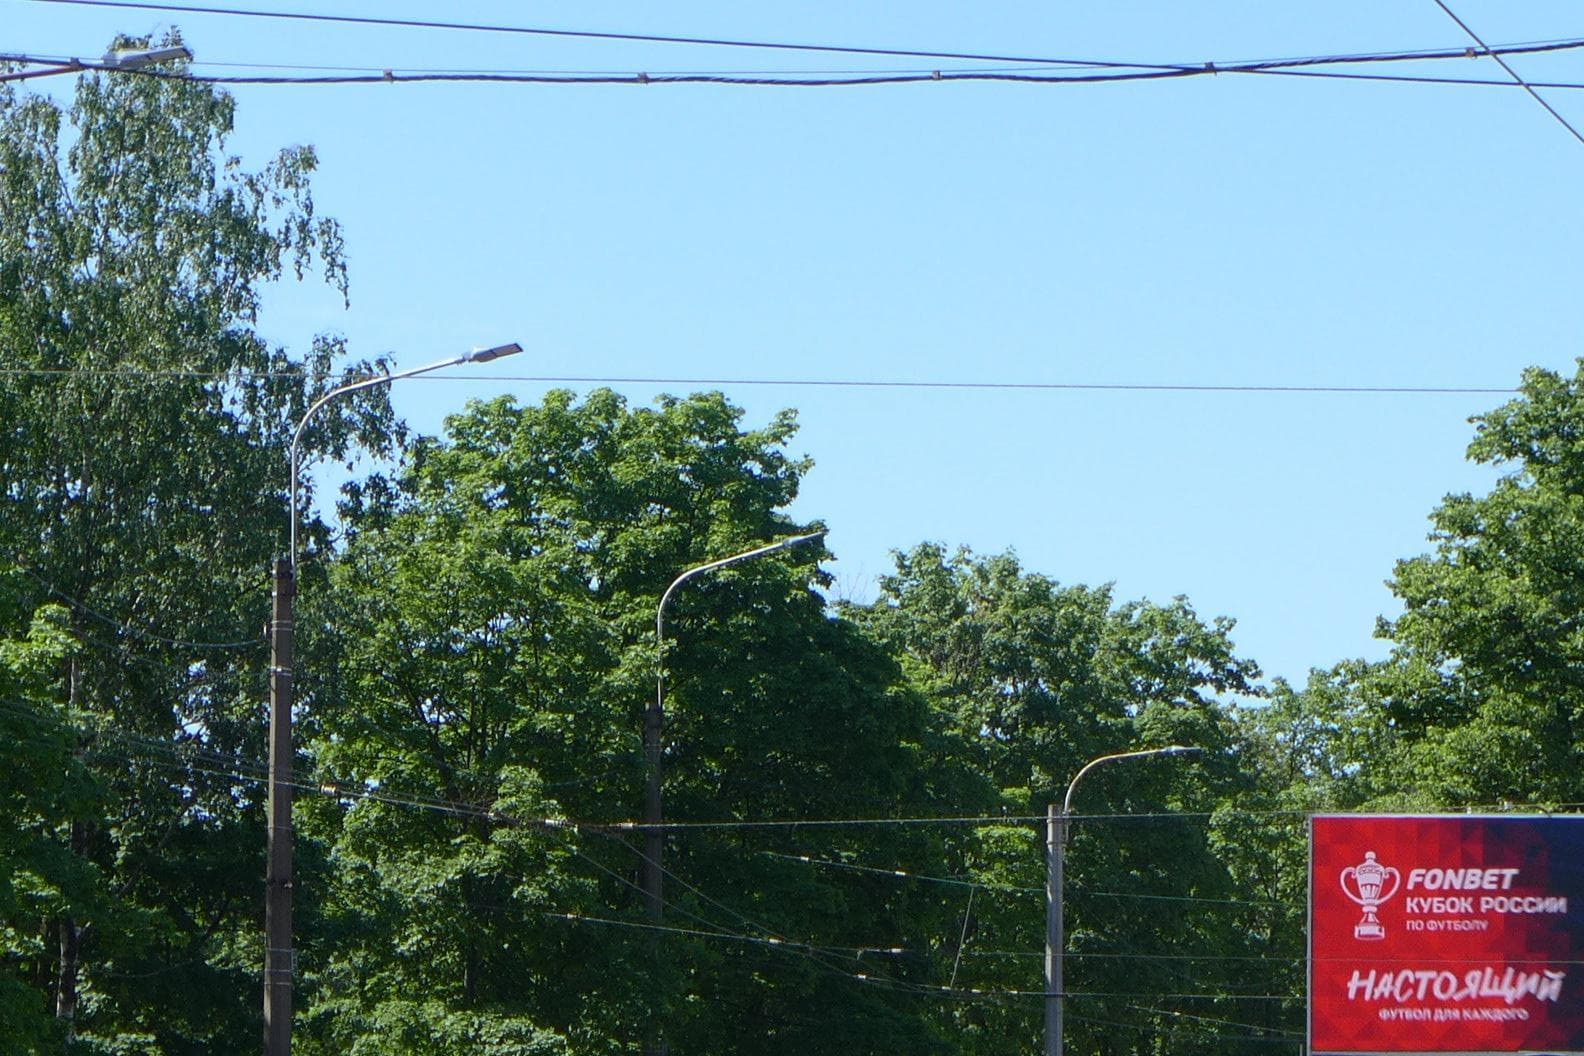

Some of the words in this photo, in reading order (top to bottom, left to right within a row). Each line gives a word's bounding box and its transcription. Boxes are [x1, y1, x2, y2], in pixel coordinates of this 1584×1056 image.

[1406, 868, 1519, 890] FONBET
[1406, 896, 1475, 914] КУБОК
[1480, 896, 1568, 914] РОССИИ
[1406, 919, 1424, 931] ПО
[1426, 919, 1489, 932] ФУТБОЛУ
[1347, 966, 1566, 1004] НАСТОЯЩИЙ
[1379, 1007, 1432, 1021] ФУТБОЛ
[1433, 1007, 1460, 1021] ДЛЯ
[1463, 1007, 1529, 1021] КАЖДОГО
